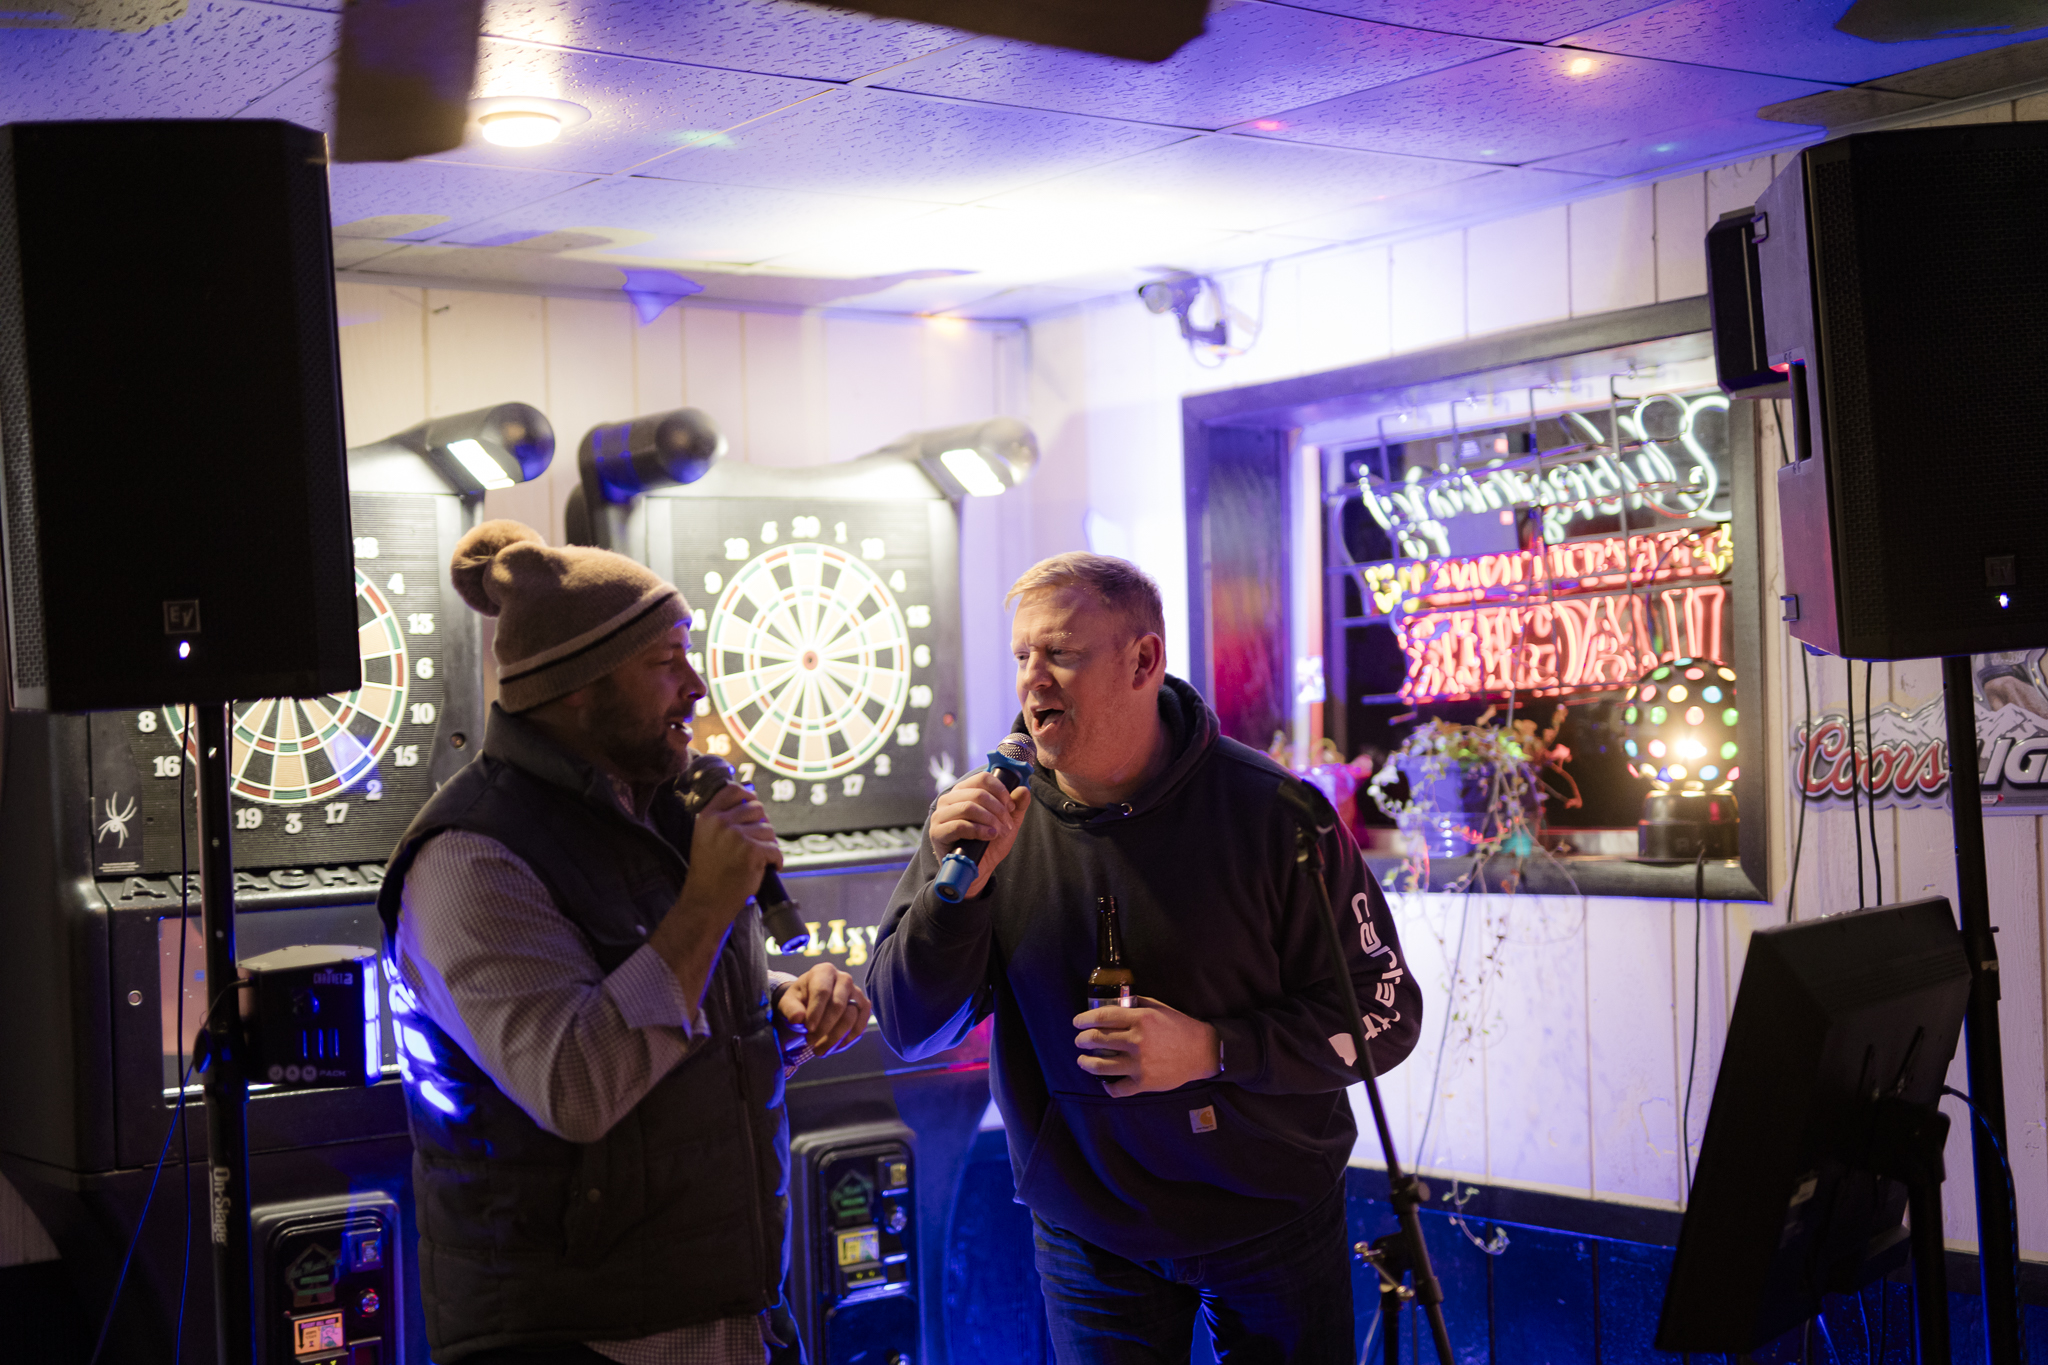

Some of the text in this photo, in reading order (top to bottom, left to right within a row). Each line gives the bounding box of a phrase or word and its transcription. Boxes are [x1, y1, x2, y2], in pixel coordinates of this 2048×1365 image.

[834, 521, 848, 544] 1
[388, 573, 405, 595] 4
[889, 569, 906, 593] 4
[407, 614, 434, 634] 13
[913, 644, 931, 668] 6
[416, 658, 434, 679] 6
[909, 685, 933, 708] 10
[138, 711, 157, 733] 8
[410, 703, 435, 724] 10
[706, 734, 731, 756] 16
[897, 723, 919, 746] 15
[153, 757, 181, 777] 16
[394, 746, 418, 767] 15
[875, 754, 891, 776] 2
[1799, 719, 2048, 796] Coors IG
[738, 762, 756, 782] 7
[366, 779, 382, 800] 2
[771, 779, 796, 801] 19
[810, 783, 828, 805] 3
[843, 774, 865, 796] 17
[236, 808, 262, 829] 19
[285, 813, 302, 834] 3
[324, 803, 349, 823] 17
[213, 1166, 231, 1244] On-Stage
